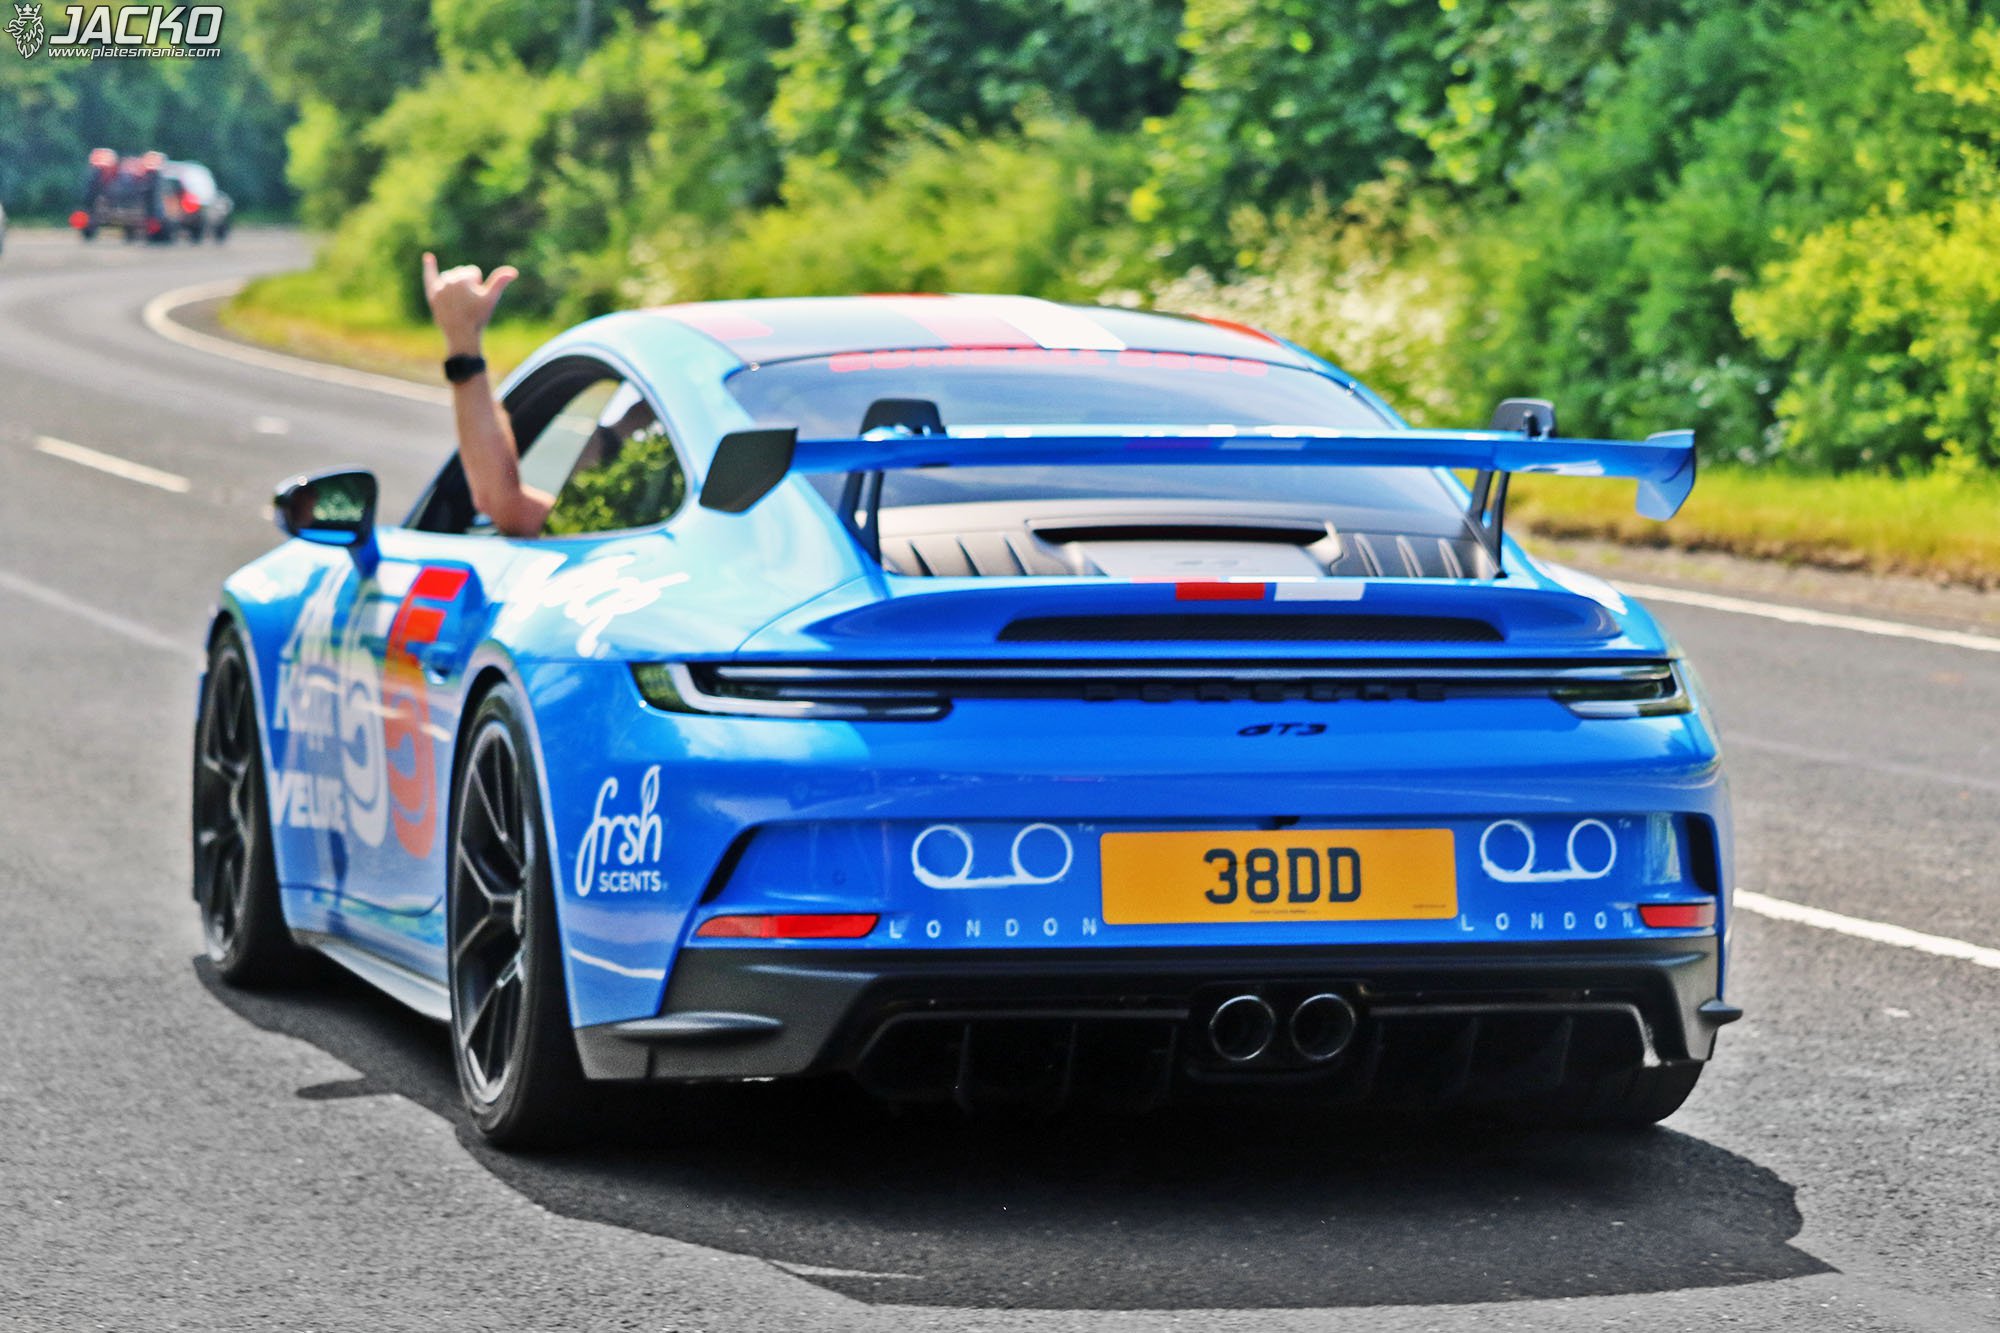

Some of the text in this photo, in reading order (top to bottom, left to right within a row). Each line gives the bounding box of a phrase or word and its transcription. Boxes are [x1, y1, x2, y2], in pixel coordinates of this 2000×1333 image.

[1237, 722, 1328, 736] GT3
[576, 765, 662, 896] frsh
[599, 870, 662, 892] SCENTS
[1203, 847, 1362, 904] 38DD
